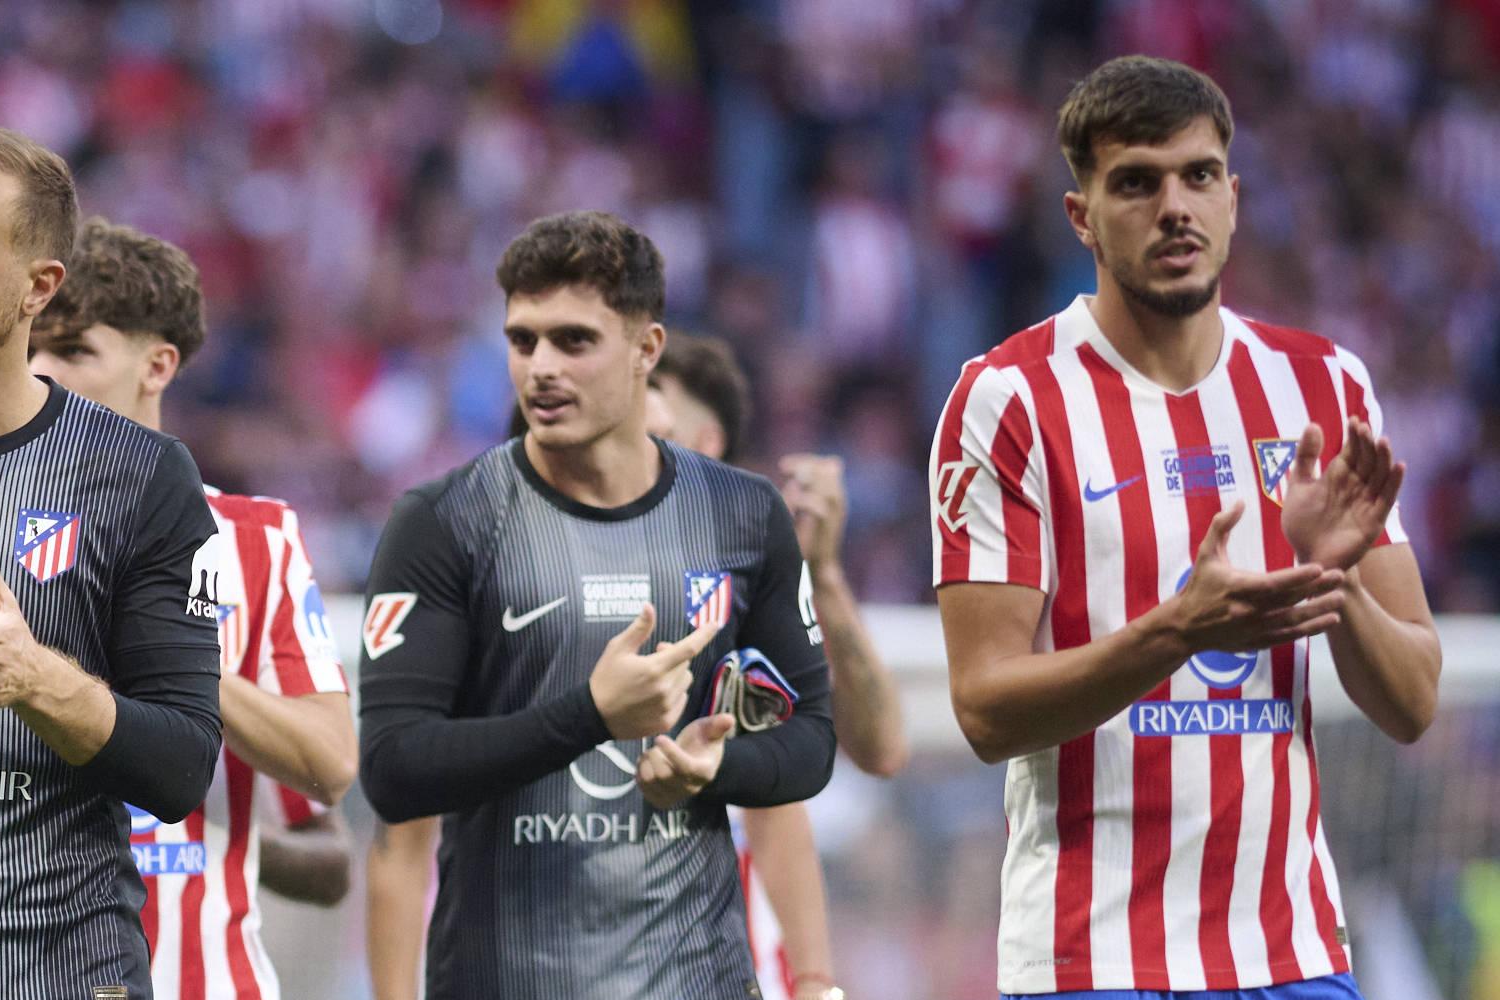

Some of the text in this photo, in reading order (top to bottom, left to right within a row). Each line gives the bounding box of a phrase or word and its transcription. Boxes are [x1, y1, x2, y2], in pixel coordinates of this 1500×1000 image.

[1164, 454, 1232, 474] GOOR
[185, 597, 216, 618] Kra
[1138, 702, 1291, 733] RIYADH AIR
[514, 809, 690, 845] RIYADH AIR
